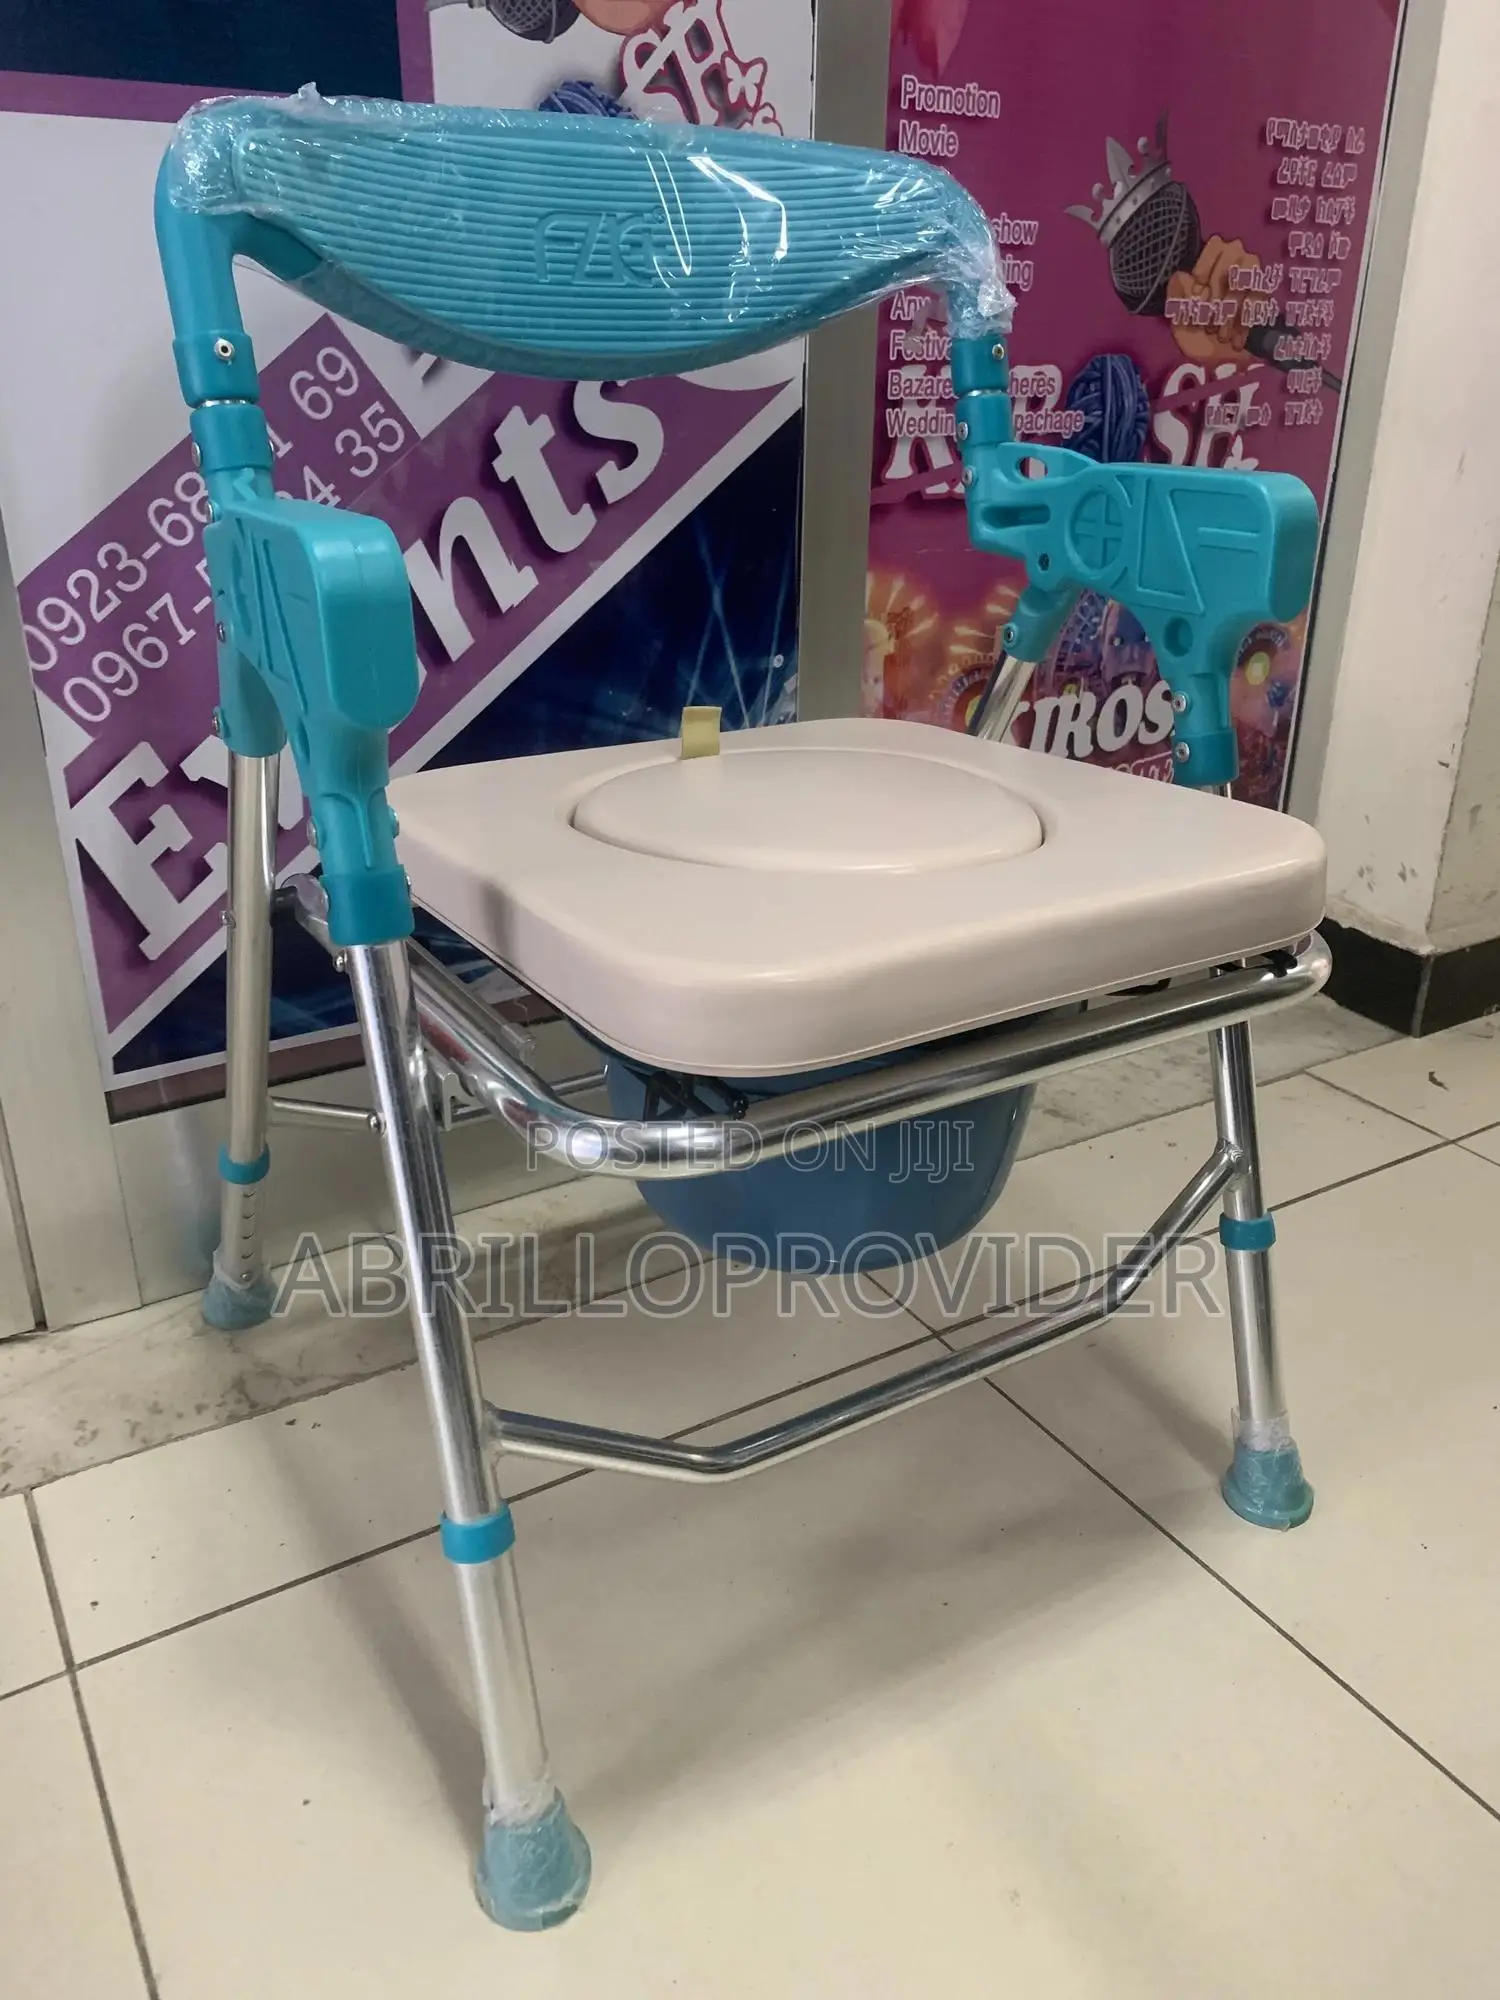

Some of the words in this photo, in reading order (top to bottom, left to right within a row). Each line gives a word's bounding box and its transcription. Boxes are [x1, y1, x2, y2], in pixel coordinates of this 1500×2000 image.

[901, 75, 1000, 118] Promotion
[899, 120, 959, 157] Movie
[289, 346, 359, 420] 69
[886, 408, 957, 442] Weddin
[1014, 410, 1085, 439] pachage
[63, 557, 213, 723] 0967-
[335, 400, 405, 478] 35
[1005, 680, 1175, 759] IROS
